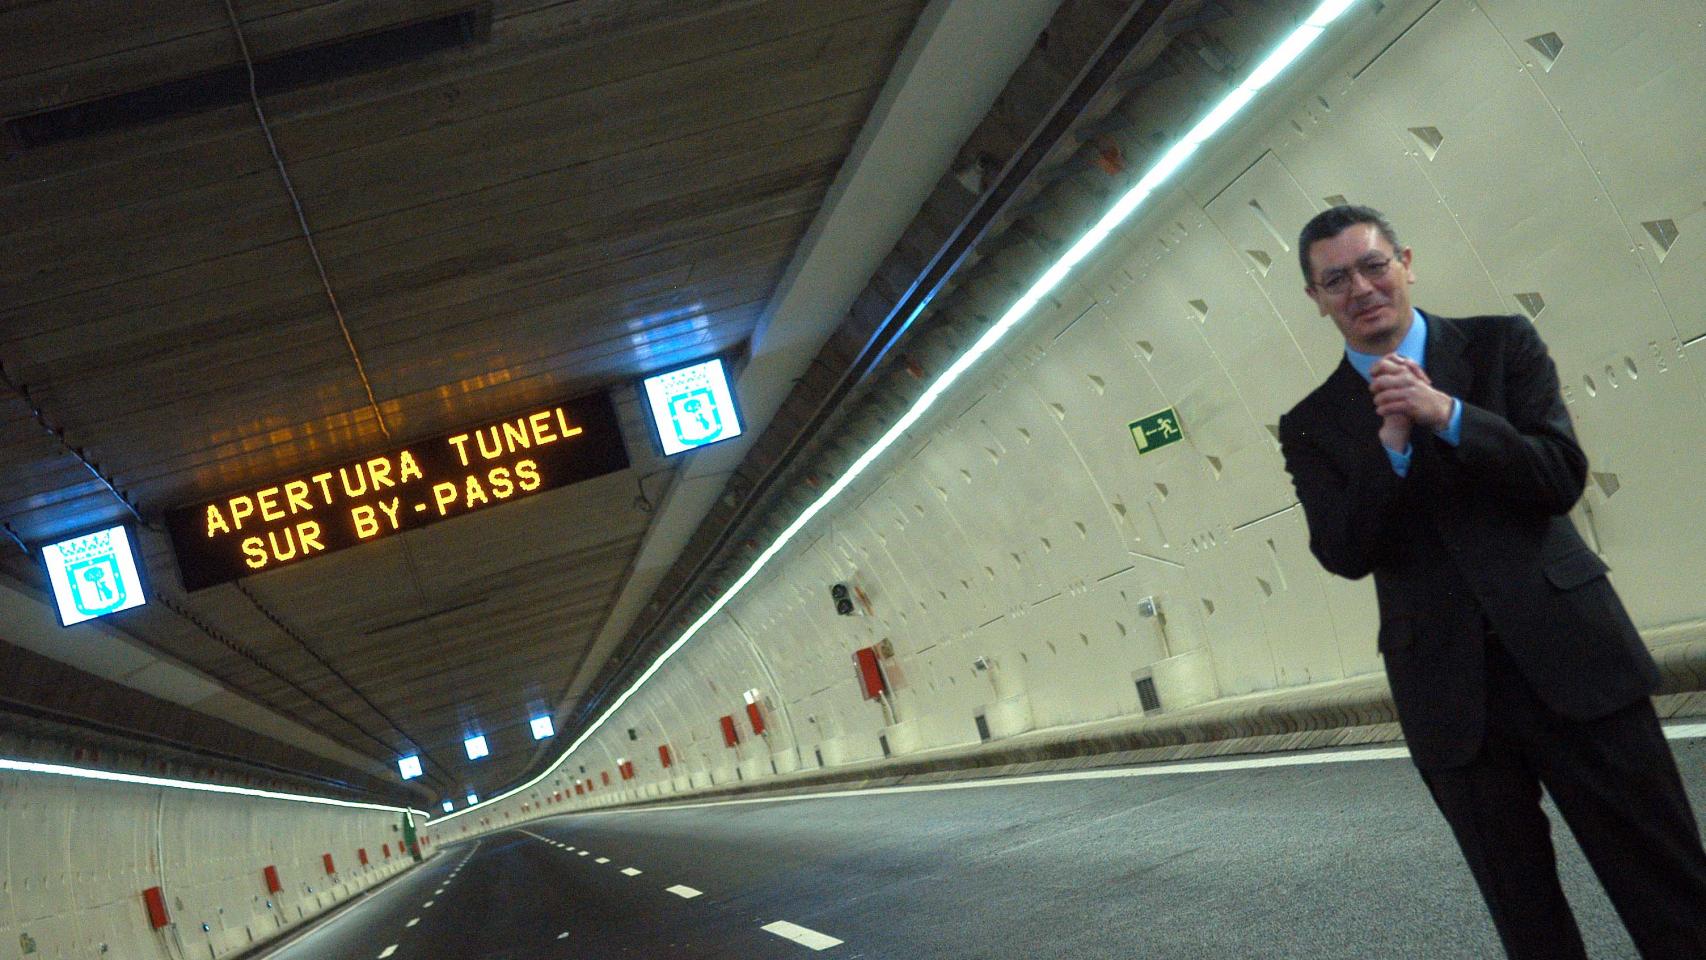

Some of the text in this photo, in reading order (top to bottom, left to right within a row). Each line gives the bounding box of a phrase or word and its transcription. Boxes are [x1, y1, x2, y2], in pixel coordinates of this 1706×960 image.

[206, 407, 583, 538] APERTURA TUNEL
[241, 458, 541, 570] SUR BY-PASS
